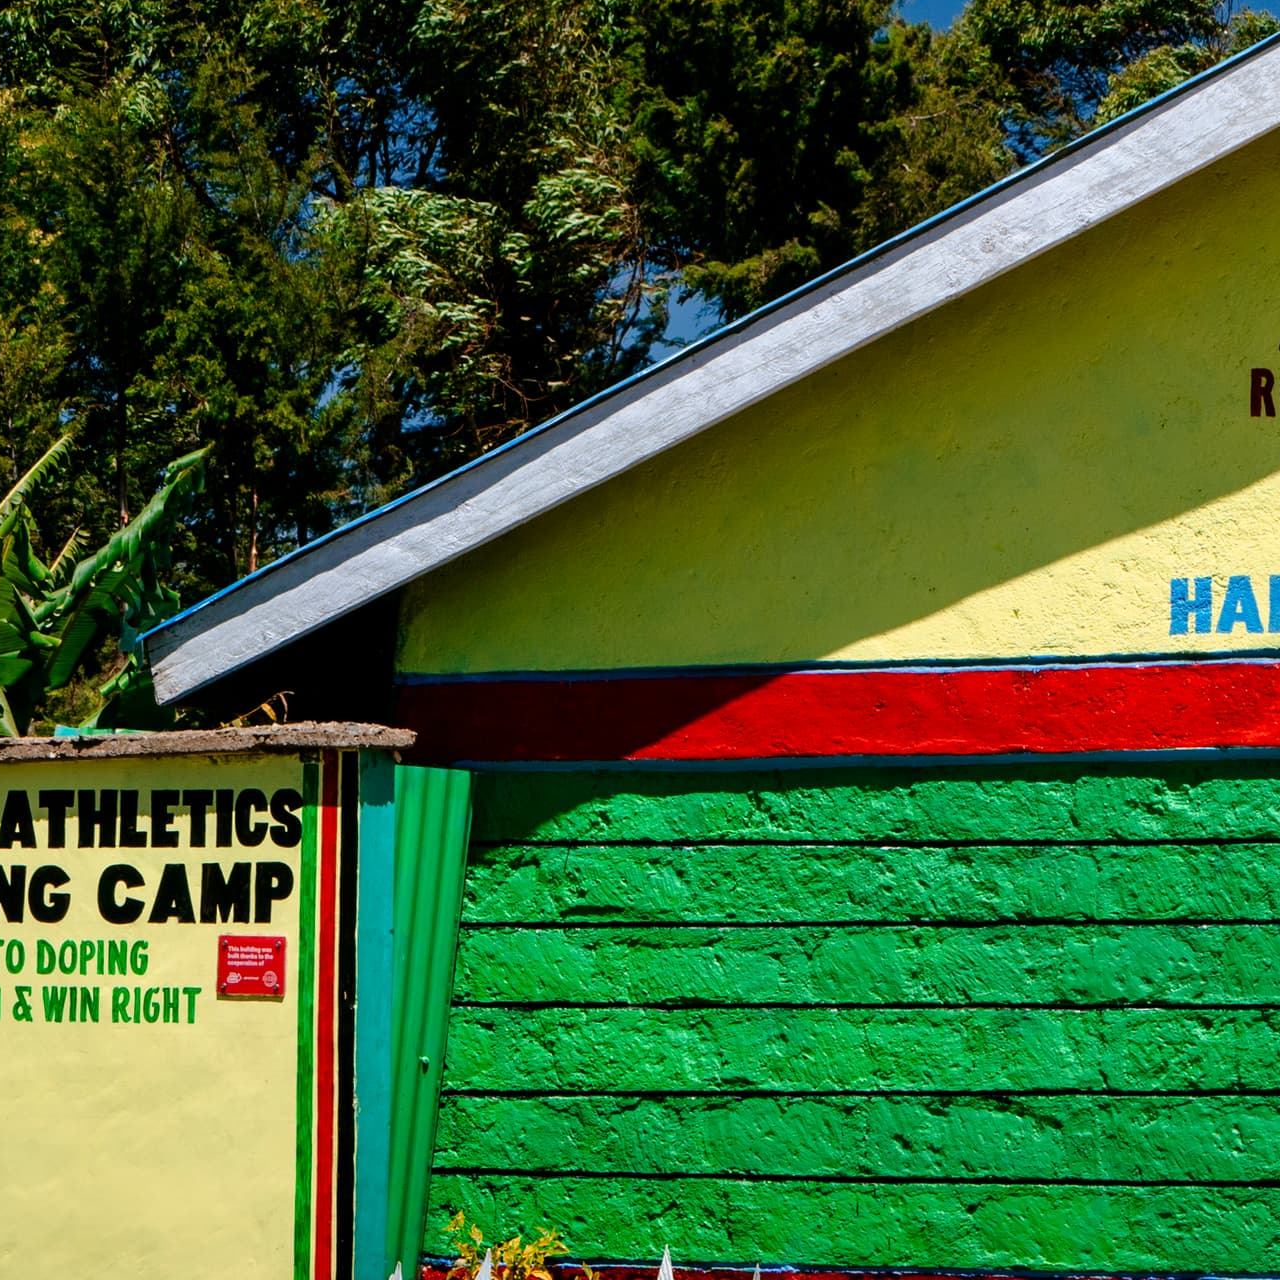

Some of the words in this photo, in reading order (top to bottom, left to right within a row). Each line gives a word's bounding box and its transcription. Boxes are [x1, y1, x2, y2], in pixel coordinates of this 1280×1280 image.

[97, 862, 294, 924] CAMP
[36, 938, 149, 976] DOPING
[13, 985, 33, 1023] &
[43, 985, 100, 1023] WIN
[111, 986, 203, 1025] RIGHT
